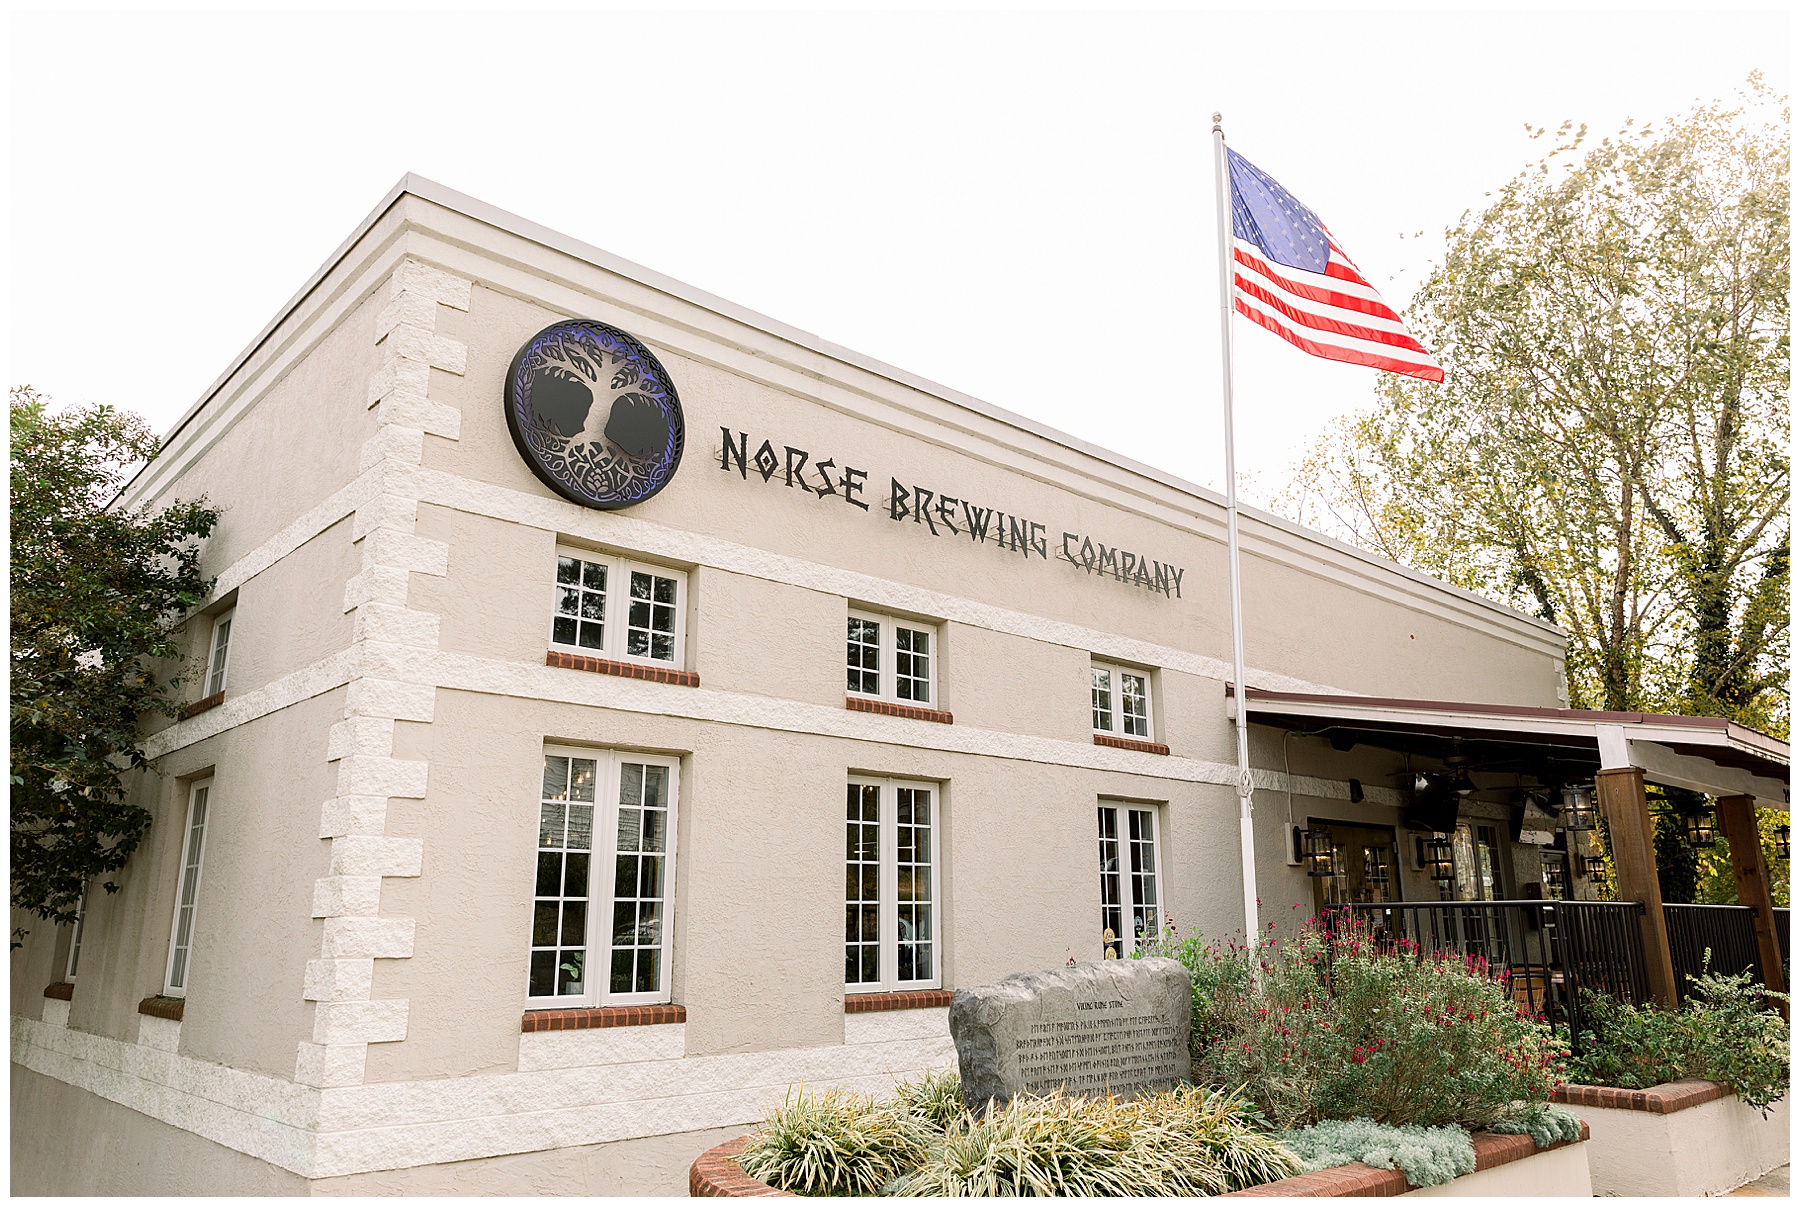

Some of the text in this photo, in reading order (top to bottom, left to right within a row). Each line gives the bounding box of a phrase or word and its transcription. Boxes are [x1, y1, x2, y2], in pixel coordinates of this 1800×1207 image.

[720, 426, 1185, 599] NORSE BREWING COMPANY
